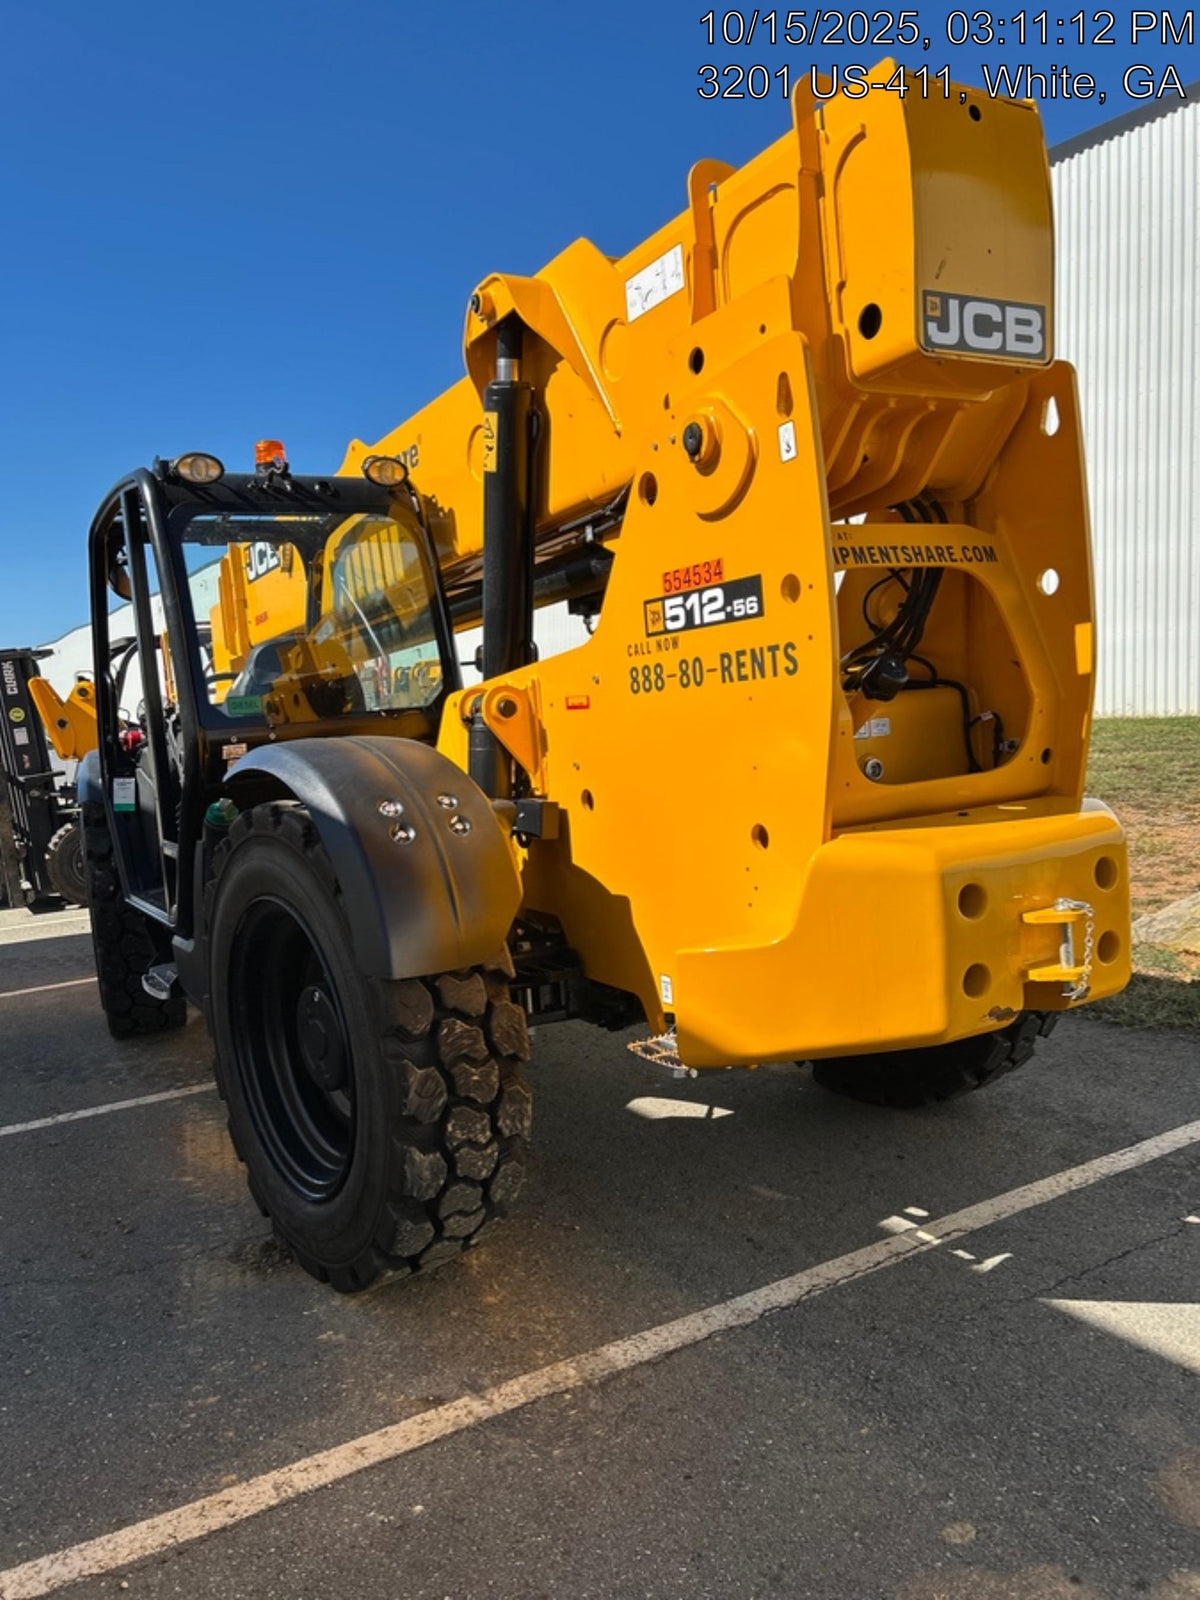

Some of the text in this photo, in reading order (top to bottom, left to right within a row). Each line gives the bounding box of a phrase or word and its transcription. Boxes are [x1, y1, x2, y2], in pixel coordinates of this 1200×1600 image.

[927, 298, 1043, 354] JCB
[832, 545, 998, 565] IPMENTSHARE.COM
[663, 558, 723, 593] 554534
[627, 636, 680, 657] CALL NOW
[1, 660, 18, 695] CLARK
[629, 641, 798, 694] 888-80-RENTS
